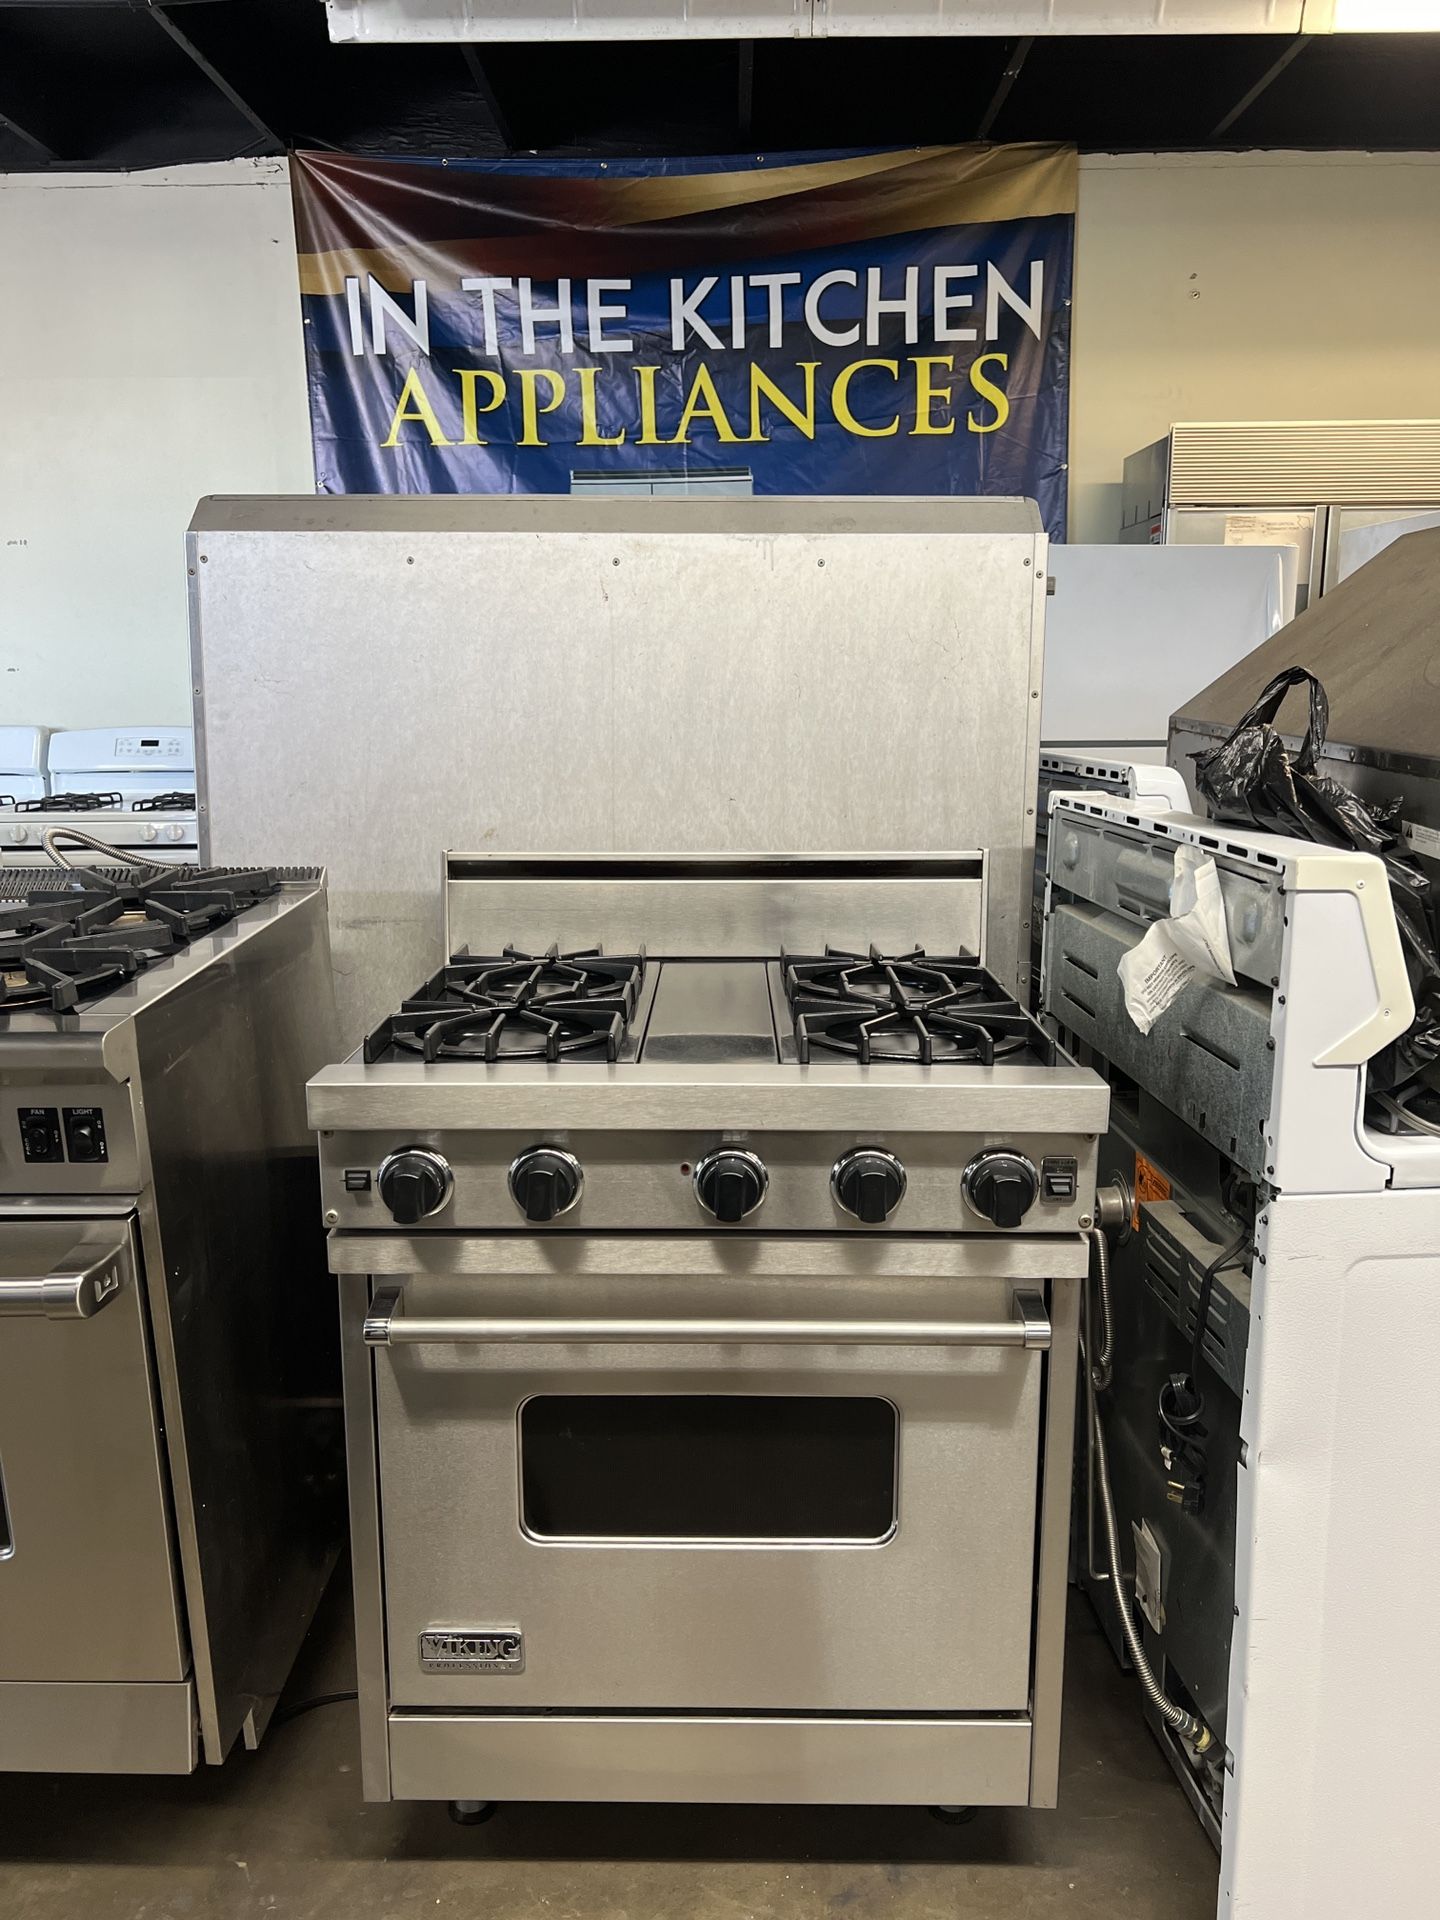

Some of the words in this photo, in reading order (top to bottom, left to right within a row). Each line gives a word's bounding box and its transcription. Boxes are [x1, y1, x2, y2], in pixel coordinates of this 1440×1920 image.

[346, 276, 430, 356] IN
[461, 276, 633, 356] THE
[670, 260, 1044, 351] KITCHEN
[379, 352, 1011, 448] APPLIANCES
[1144, 955, 1167, 984] IMPORTANT
[421, 1634, 520, 1659] VIKING
